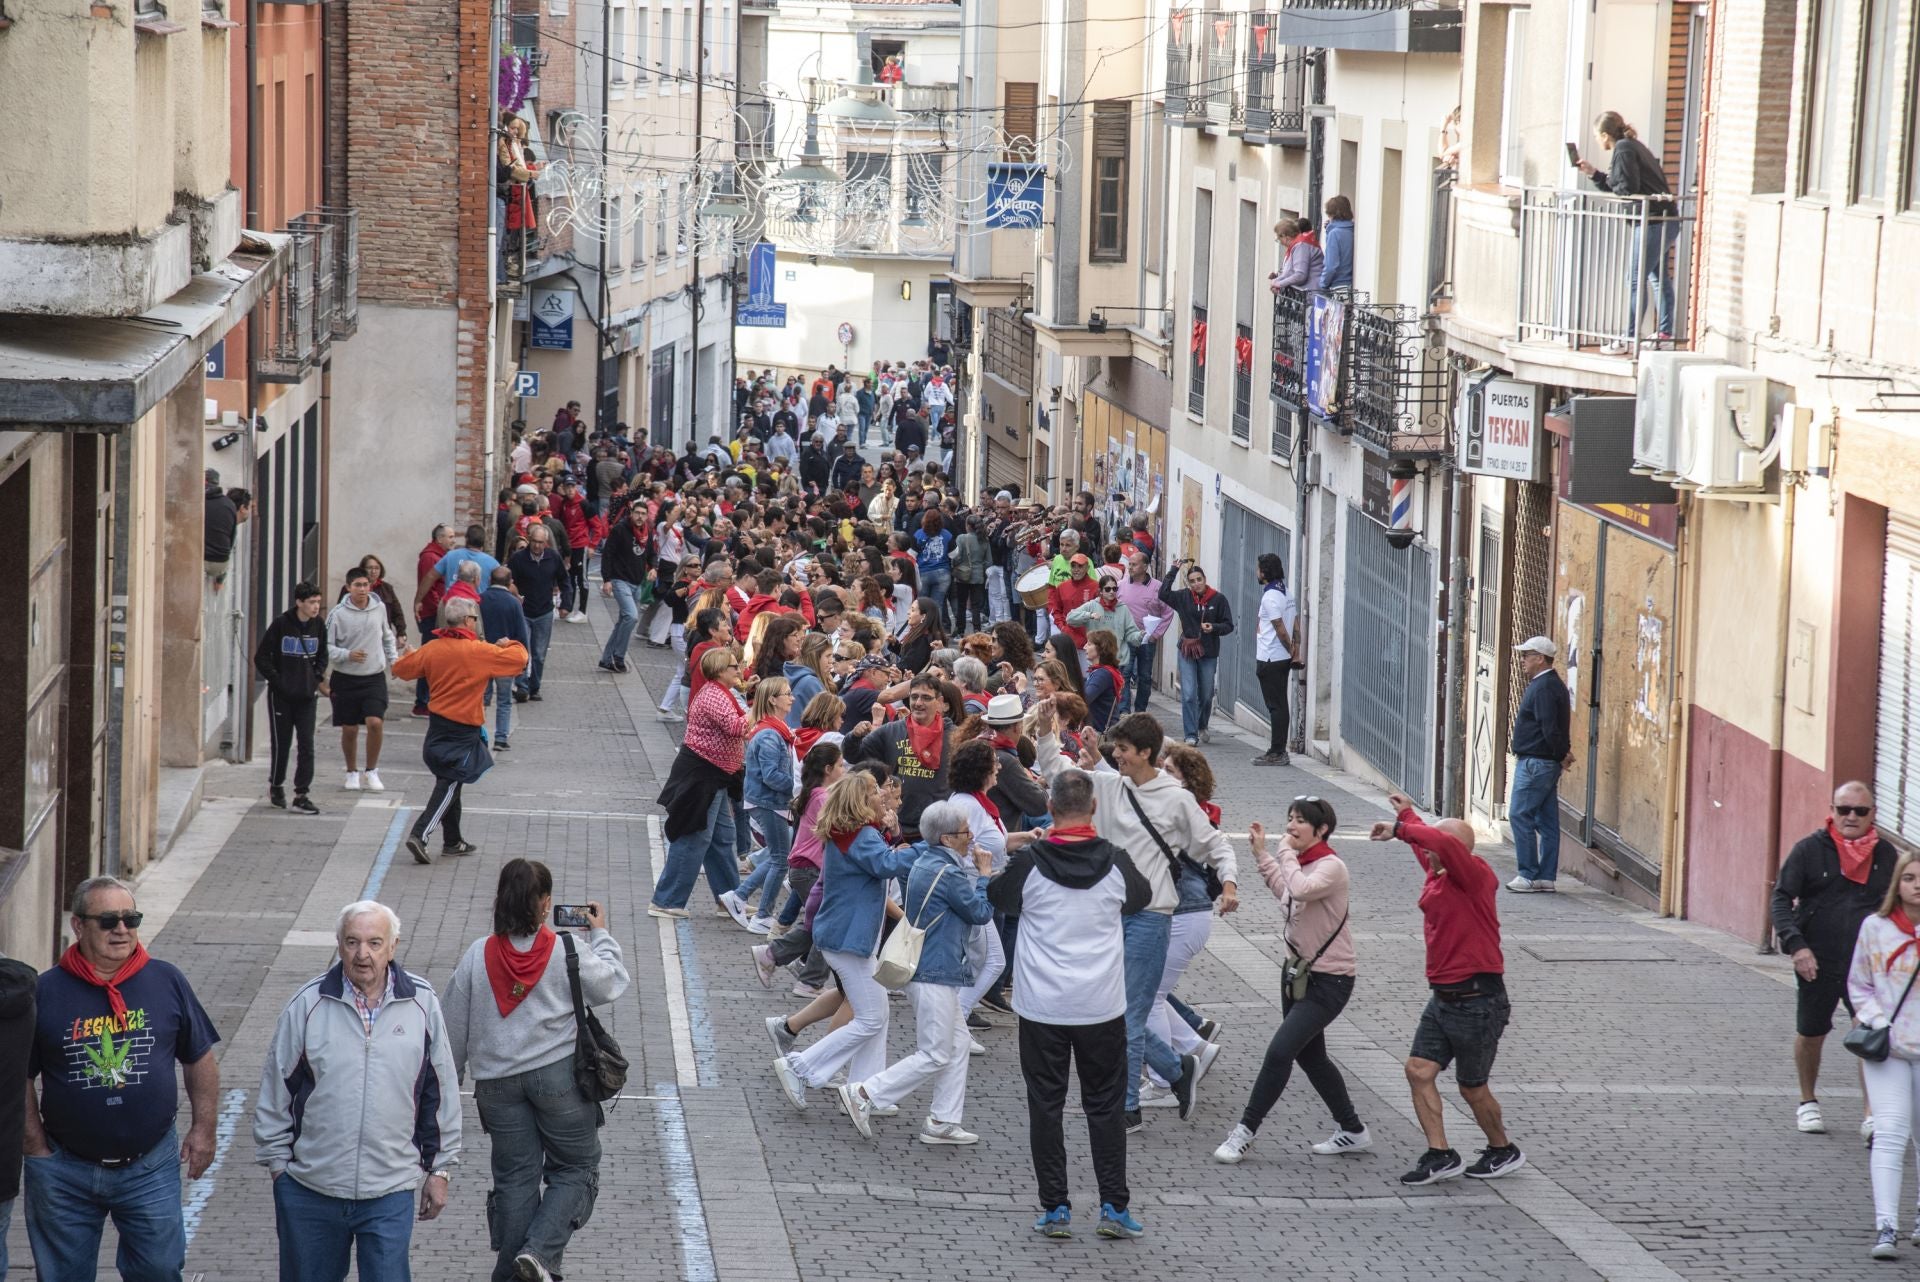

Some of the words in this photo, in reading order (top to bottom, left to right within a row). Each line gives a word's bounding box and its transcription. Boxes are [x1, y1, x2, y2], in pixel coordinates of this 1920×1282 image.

[519, 374, 534, 394] P
[1491, 393, 1529, 409] PUERTAS
[1488, 415, 1530, 448] TEYSAN
